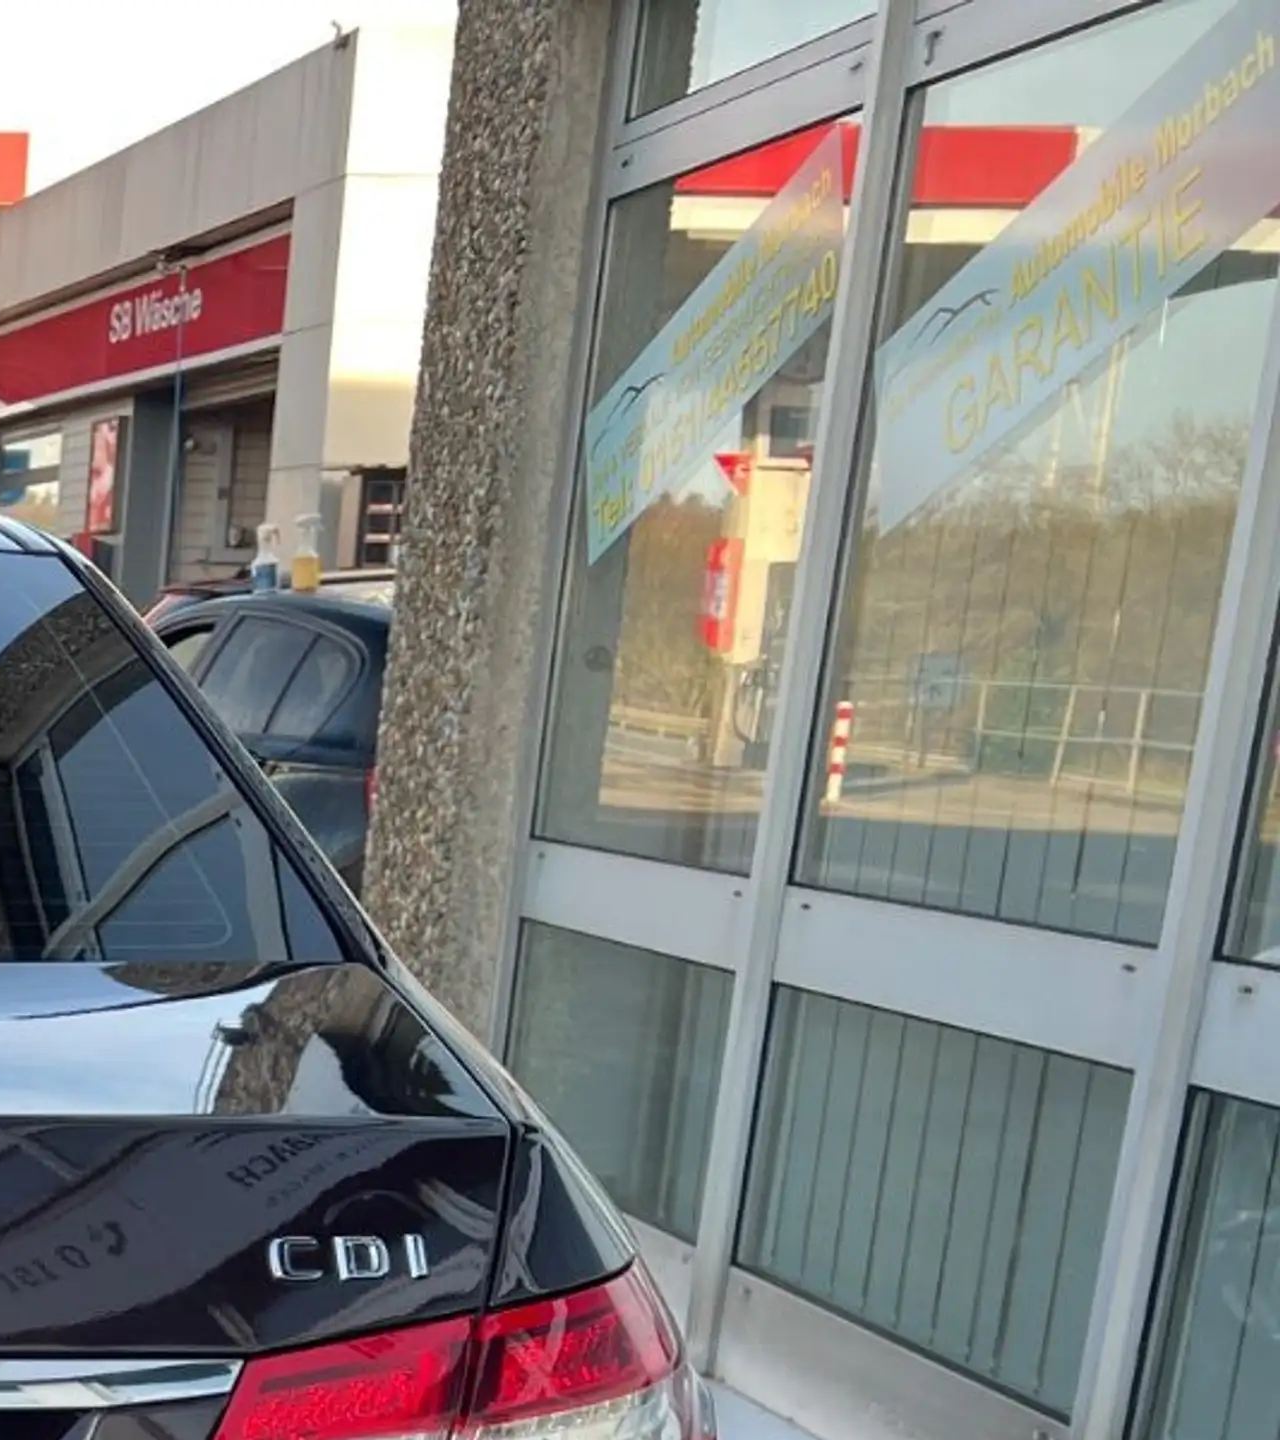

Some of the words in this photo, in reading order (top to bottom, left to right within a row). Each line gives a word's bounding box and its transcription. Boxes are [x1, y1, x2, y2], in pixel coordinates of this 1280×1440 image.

[1155, 30, 1276, 168] Morbach
[109, 300, 132, 343] SB
[134, 287, 202, 336] Wäsche
[943, 165, 1208, 454] GARANTIE
[268, 1233, 430, 1281] CDI
